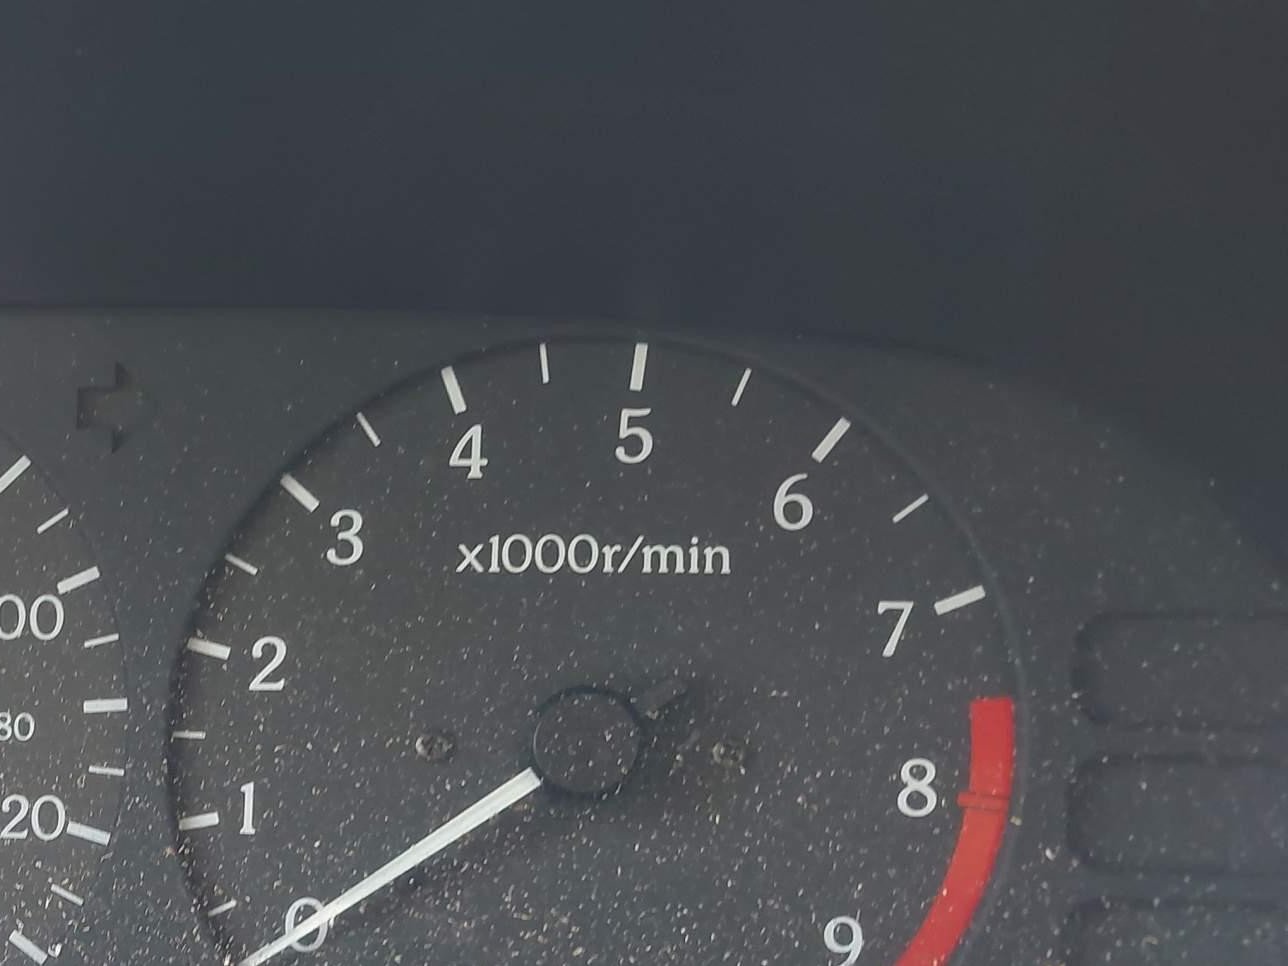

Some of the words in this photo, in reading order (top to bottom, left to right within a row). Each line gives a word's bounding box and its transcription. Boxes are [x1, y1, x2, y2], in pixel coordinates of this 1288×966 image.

[450, 425, 488, 479] 4
[615, 407, 654, 463] 5
[773, 473, 814, 531] 6
[326, 509, 364, 565] 3
[456, 534, 732, 575] x1000r/min
[876, 601, 913, 658] 7
[249, 636, 287, 691] 2
[238, 783, 256, 835] 1
[897, 759, 937, 818] 8
[285, 897, 328, 952] 0
